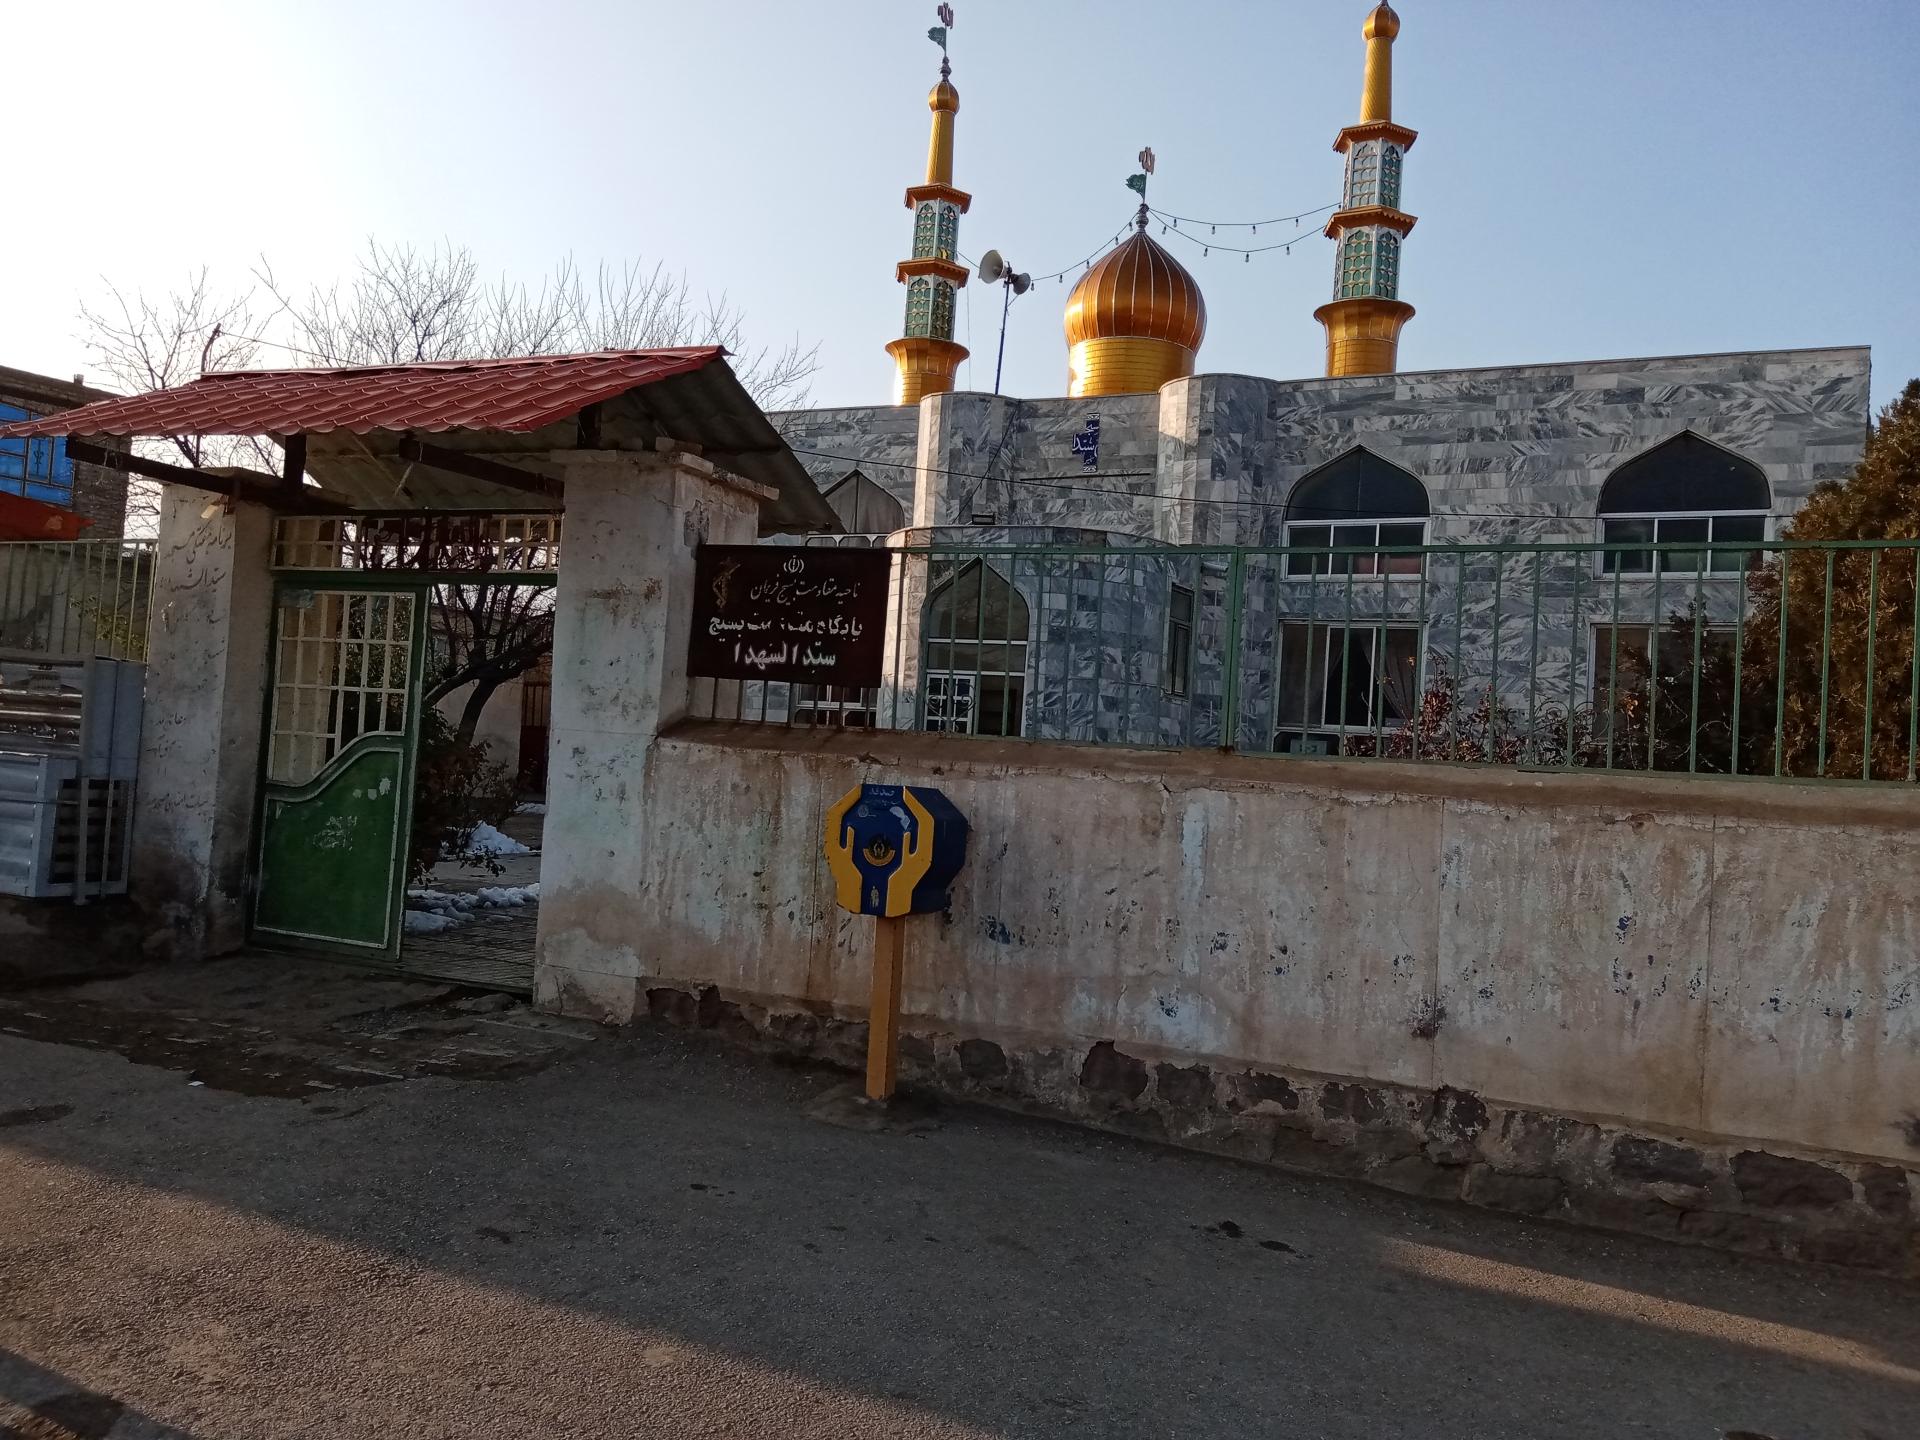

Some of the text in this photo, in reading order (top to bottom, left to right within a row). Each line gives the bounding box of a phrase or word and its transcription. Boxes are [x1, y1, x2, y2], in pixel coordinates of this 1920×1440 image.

[776, 579, 797, 606] بسیج
[796, 577, 836, 597] مقاومت
[835, 582, 861, 605] ناحیه
[708, 616, 745, 642] بسیج
